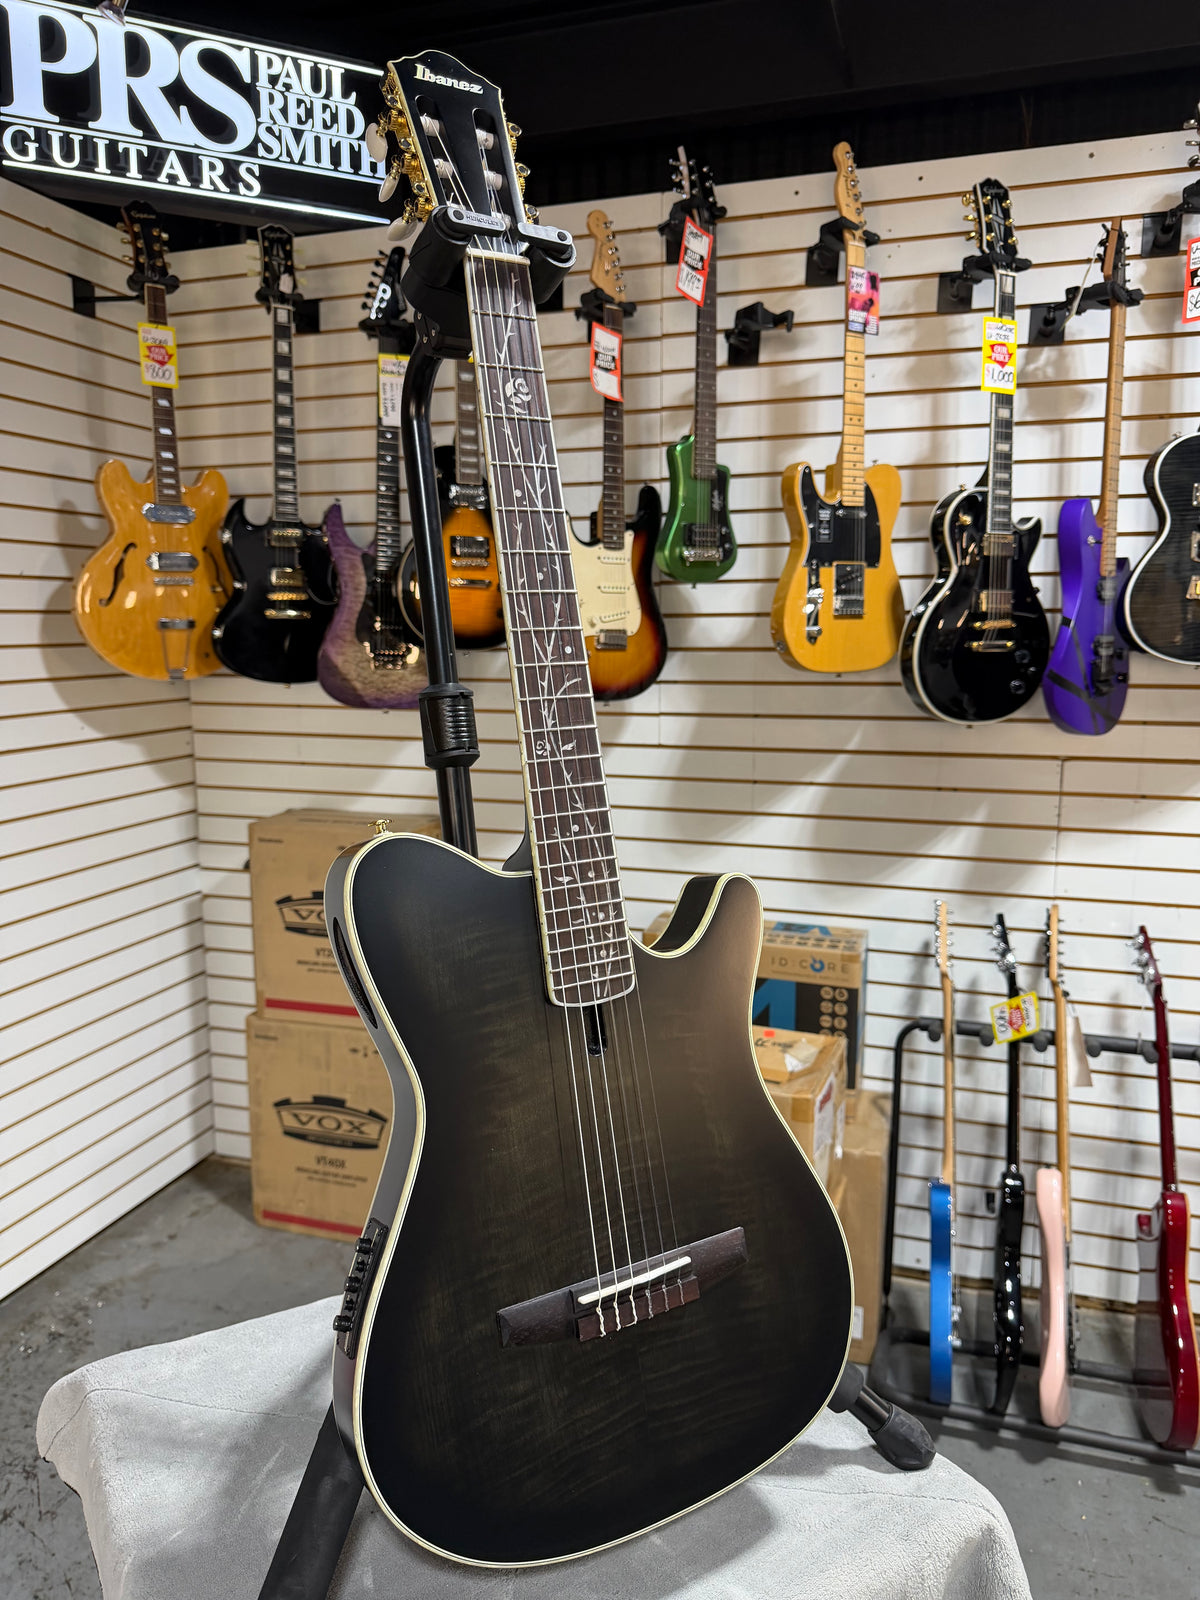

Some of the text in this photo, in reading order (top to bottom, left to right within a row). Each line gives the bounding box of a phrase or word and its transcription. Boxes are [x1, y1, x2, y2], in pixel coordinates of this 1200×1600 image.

[0, 0, 257, 153] PRS
[254, 50, 357, 105] PAUL
[413, 63, 484, 95] Ibanez
[256, 87, 366, 139] REED
[2, 125, 262, 197] GUITARS
[257, 122, 387, 179] SMITH
[290, 1111, 371, 1135] VOX
